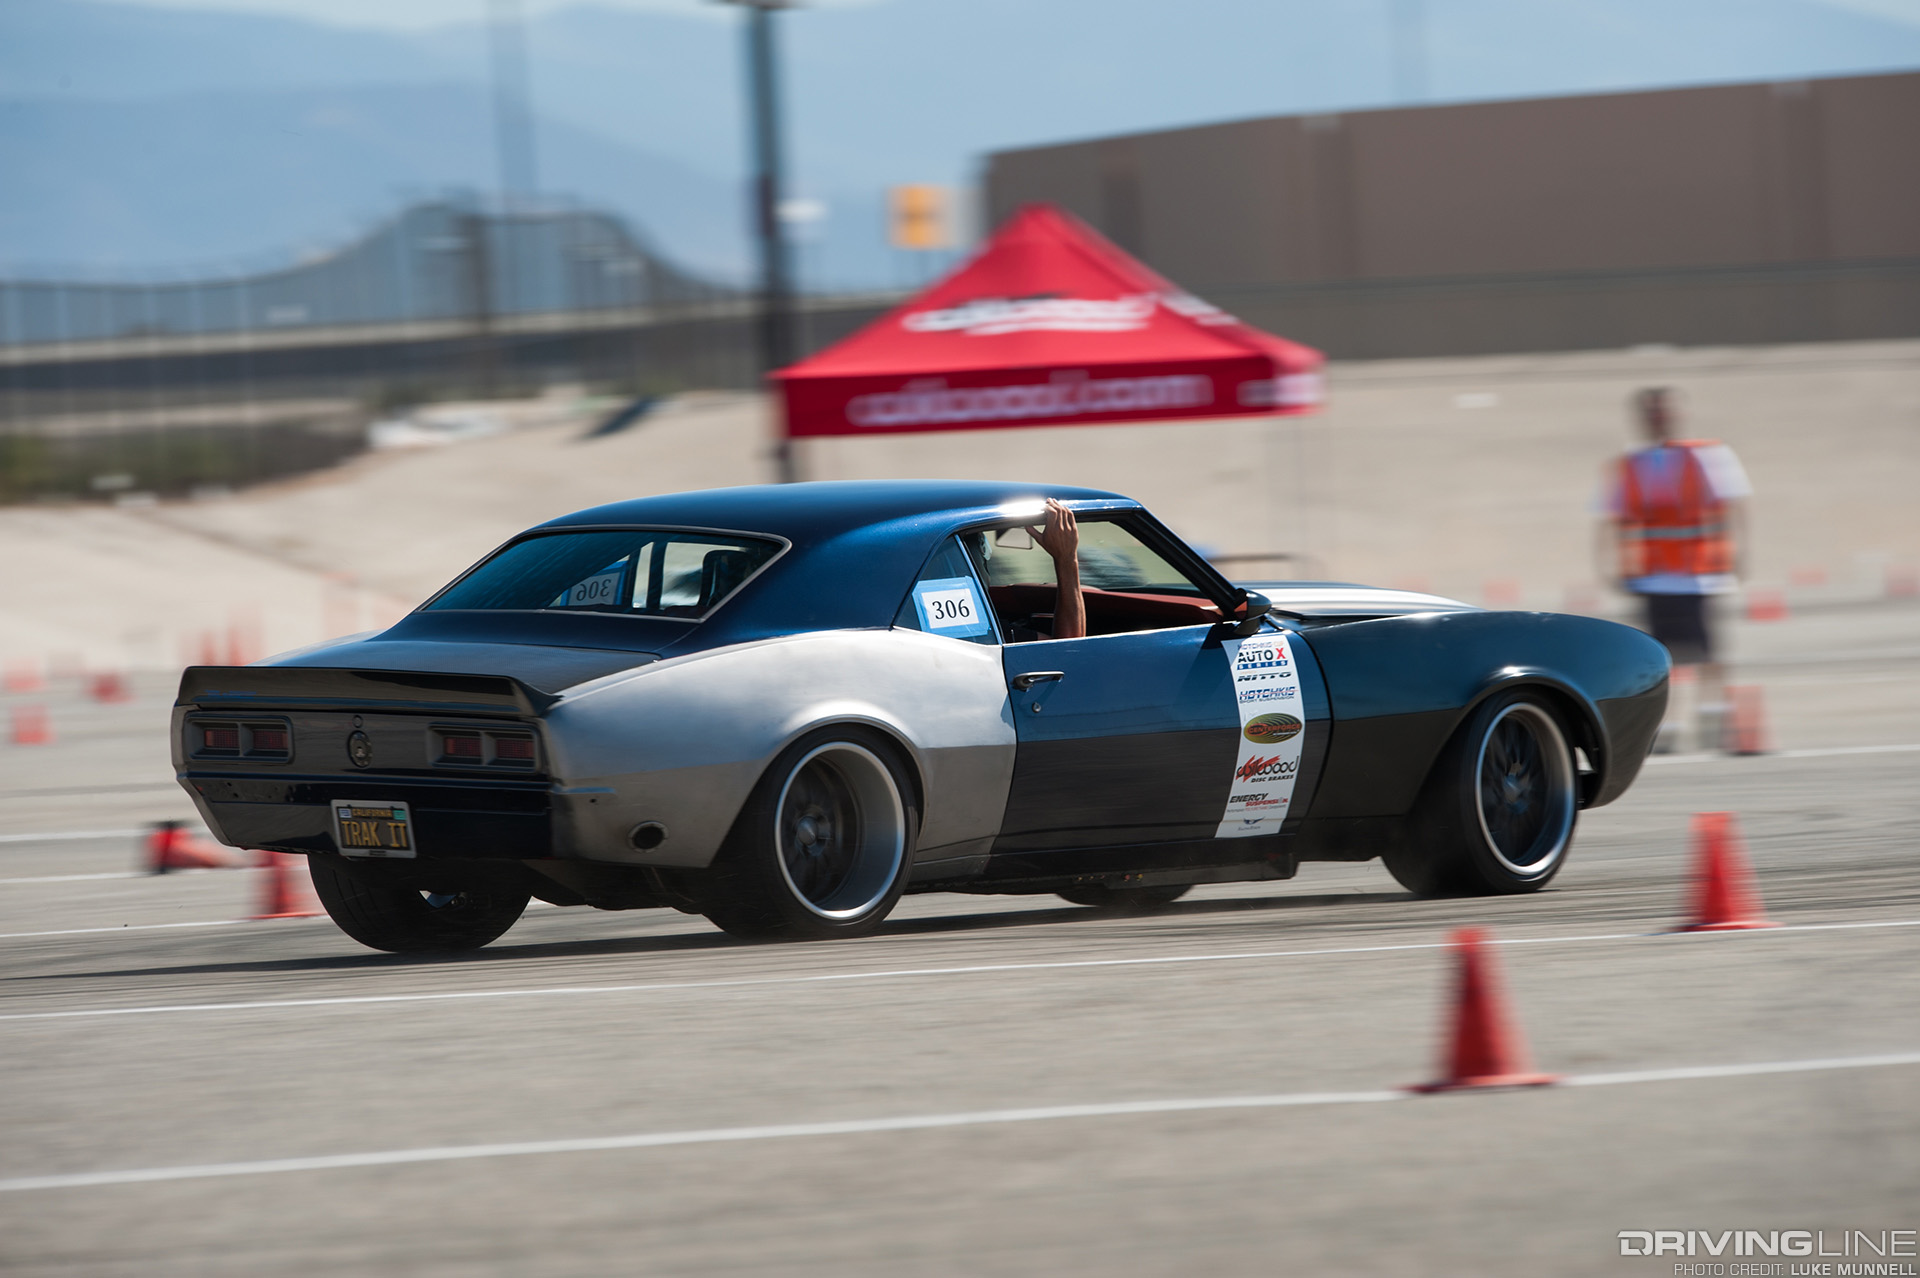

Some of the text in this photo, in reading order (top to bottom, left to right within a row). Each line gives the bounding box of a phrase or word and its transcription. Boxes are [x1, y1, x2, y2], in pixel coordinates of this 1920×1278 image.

[932, 599, 970, 620] 306
[1237, 648, 1286, 663] AUTO X
[1237, 672, 1291, 682] NITTO
[1239, 686, 1296, 700] HOTCHKIS
[1247, 724, 1301, 733] CENTERFORCE
[1268, 774, 1295, 782] BRAKES
[1229, 792, 1269, 803] ENERGY
[352, 808, 393, 818] CALIFORNIA
[341, 820, 382, 847] TRAK
